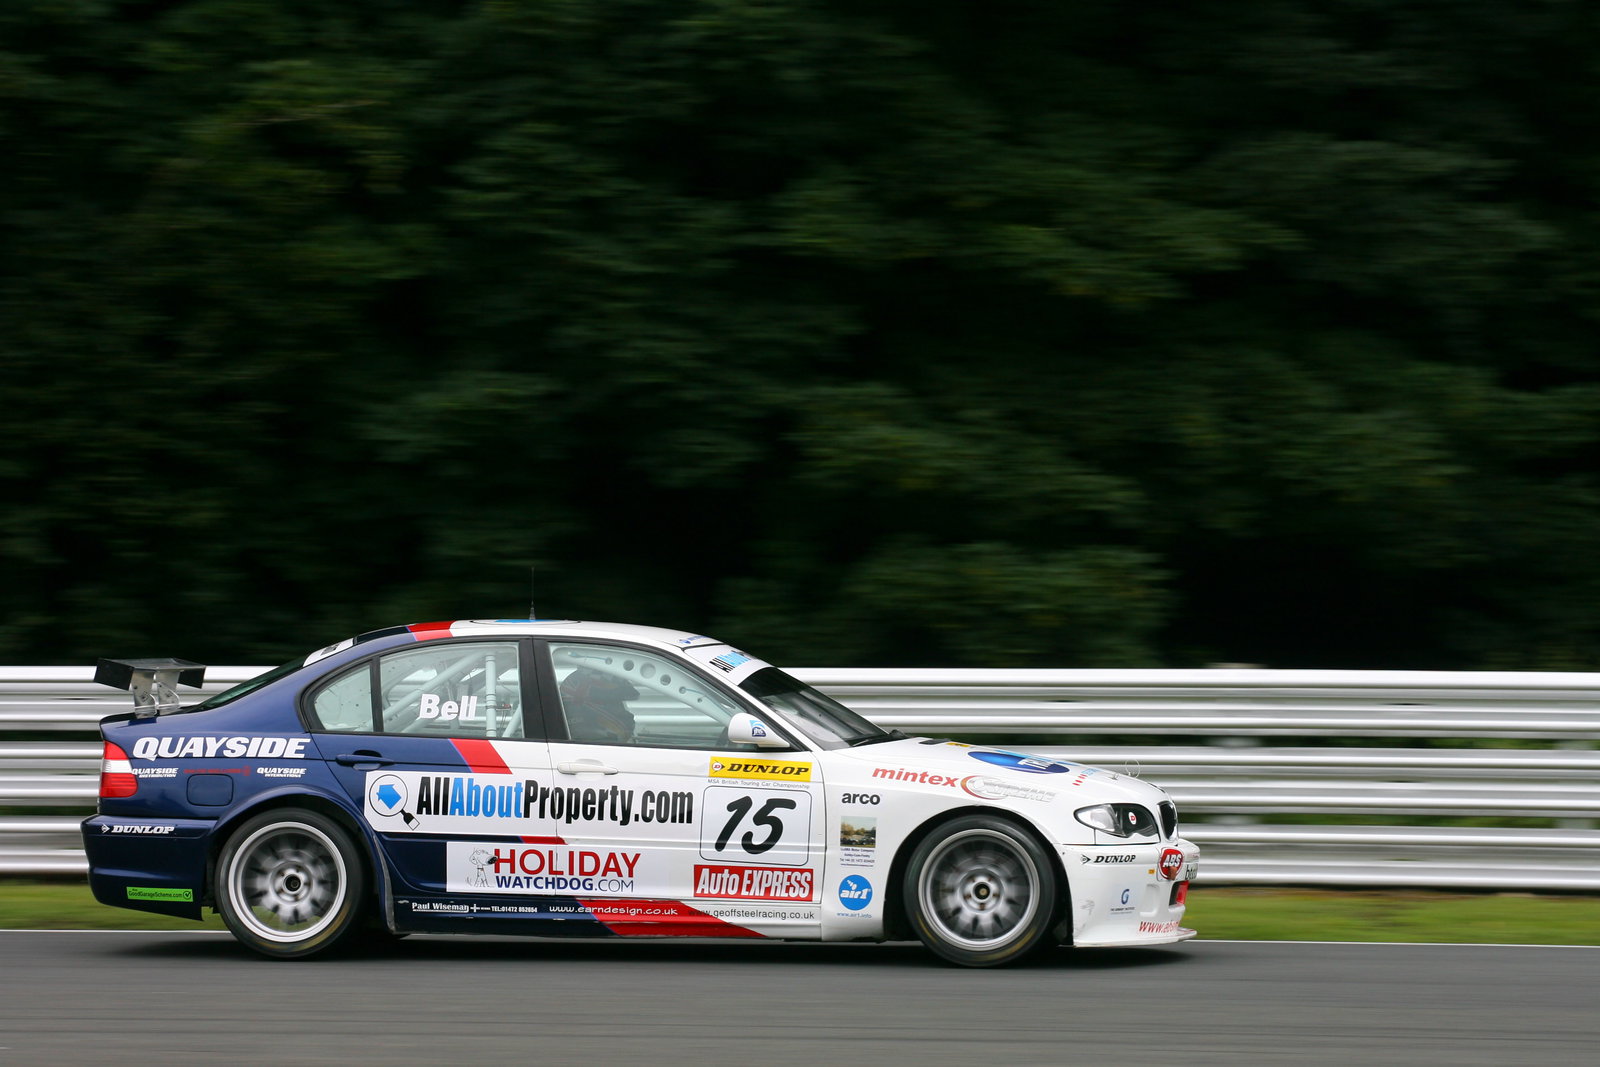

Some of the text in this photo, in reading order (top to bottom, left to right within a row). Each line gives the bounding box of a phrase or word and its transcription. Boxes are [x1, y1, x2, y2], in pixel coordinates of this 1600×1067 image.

[419, 693, 478, 721] Bell
[133, 736, 311, 761] QUAYSIDE
[132, 767, 179, 775] QUAYSIDE
[256, 767, 307, 775] QUAYSIDE
[727, 762, 809, 776] DUNLOP
[872, 767, 960, 788] mintex
[772, 781, 810, 789] Championship
[416, 776, 693, 826] AllAboutProperty.com
[841, 792, 881, 805] arco
[111, 825, 175, 834] DUNLOP
[714, 795, 797, 855] 15
[494, 848, 642, 878] HOLIDAY
[1094, 855, 1136, 863] DUNLOP
[495, 876, 634, 893] WATCHDOG.COM
[696, 868, 811, 898] Auto EXPRESS
[412, 902, 430, 910] Paul
[432, 902, 469, 912] Wiseman
[549, 905, 678, 916] www.earndesign.co.uk
[688, 909, 815, 920] www.geoffsteelracing.co.uk
